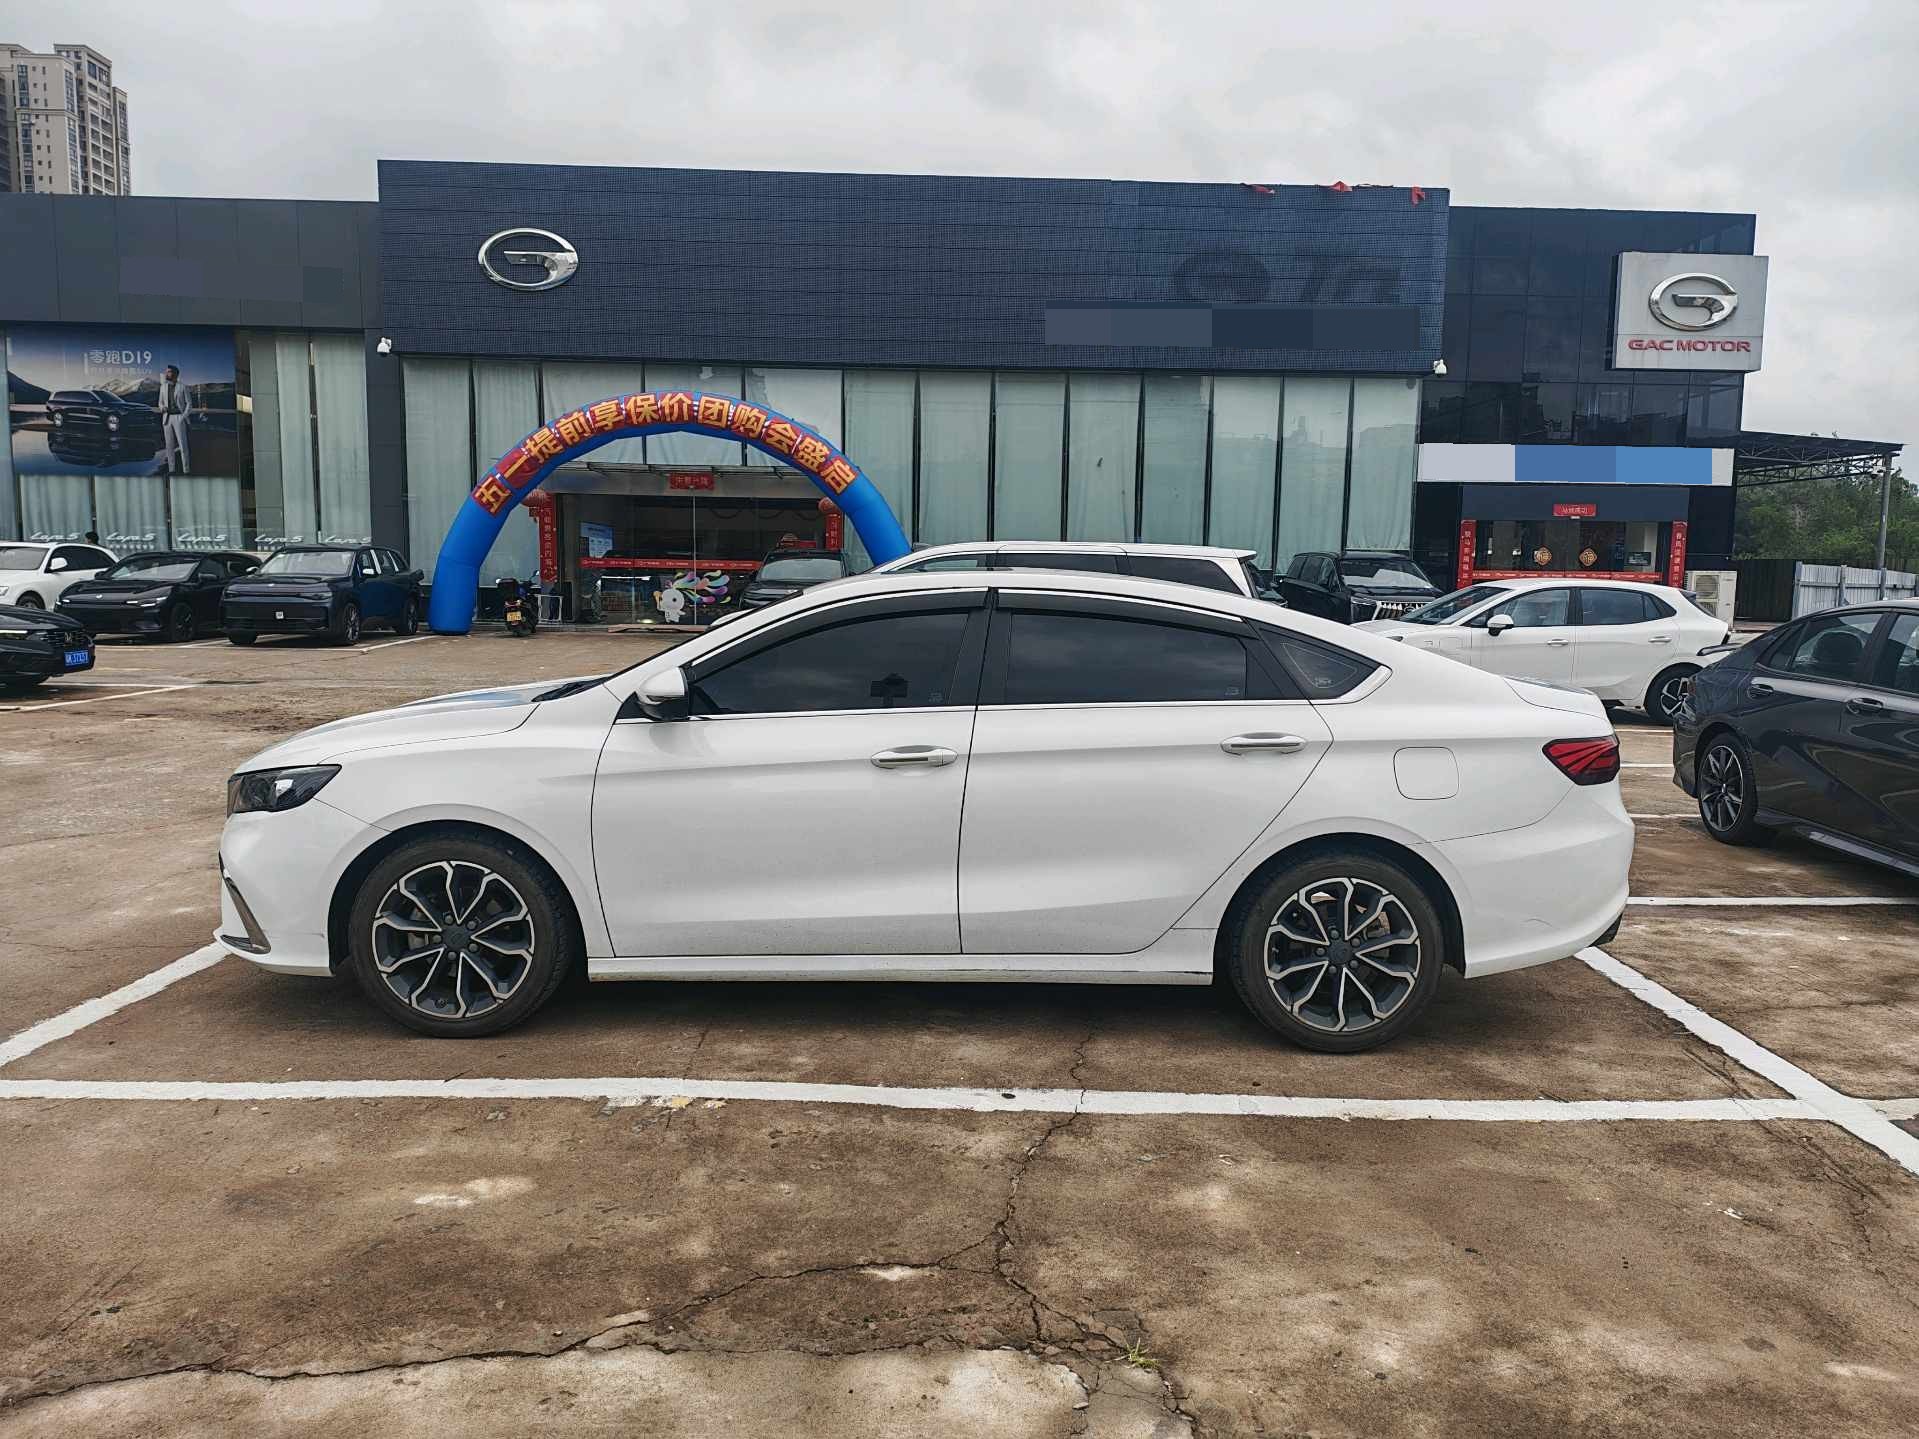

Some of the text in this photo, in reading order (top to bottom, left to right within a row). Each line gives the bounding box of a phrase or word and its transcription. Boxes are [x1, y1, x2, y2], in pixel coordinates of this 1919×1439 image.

[1628, 339, 1751, 352] GAC MOTOR
[474, 393, 857, 513] 五一提前享保价团购会盛启
